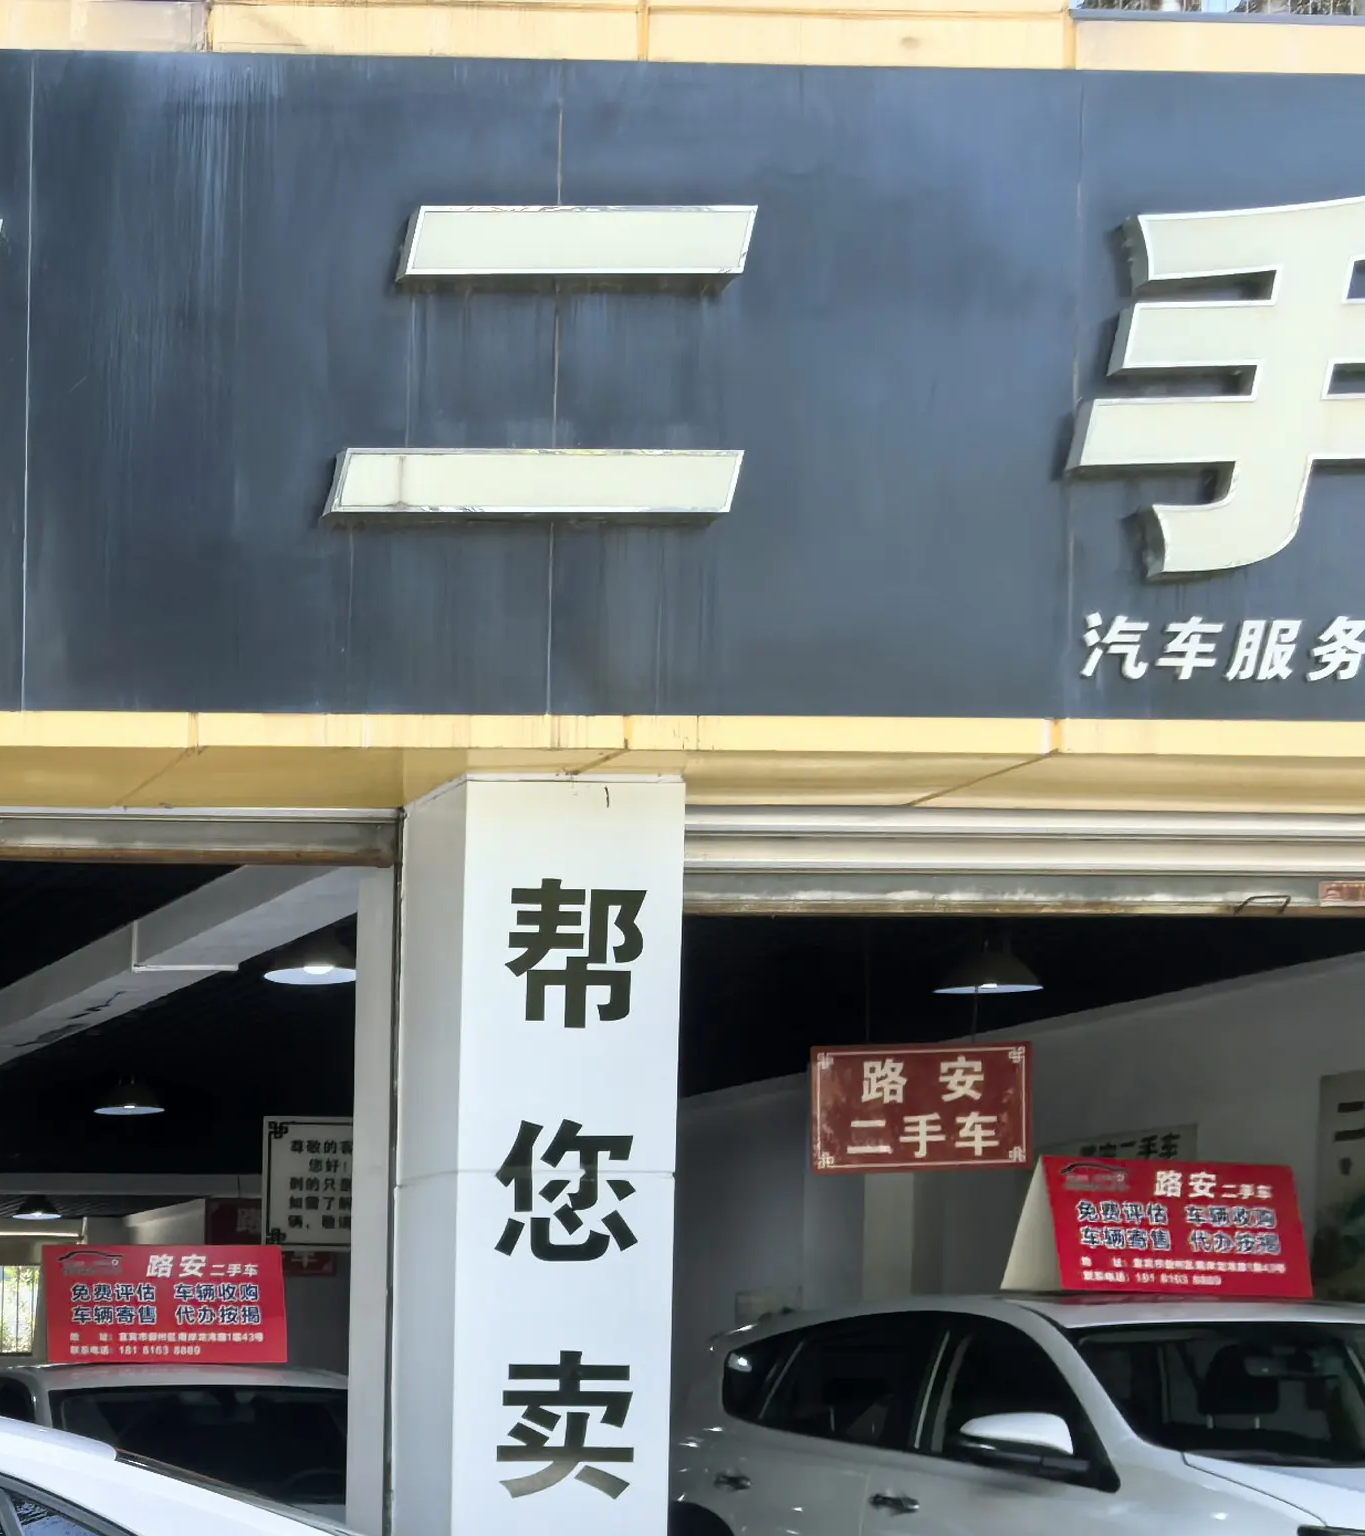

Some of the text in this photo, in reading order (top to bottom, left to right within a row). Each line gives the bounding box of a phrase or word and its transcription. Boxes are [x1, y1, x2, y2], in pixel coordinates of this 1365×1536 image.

[1068, 612, 1365, 682] 汽车服务
[860, 1055, 986, 1105] 路安
[846, 1112, 1000, 1158] 二手车
[145, 1253, 260, 1279] 路安二手车
[69, 1282, 260, 1304] 免费评估 车辆收购
[70, 1304, 262, 1327] 车辆寄售 代办按揭
